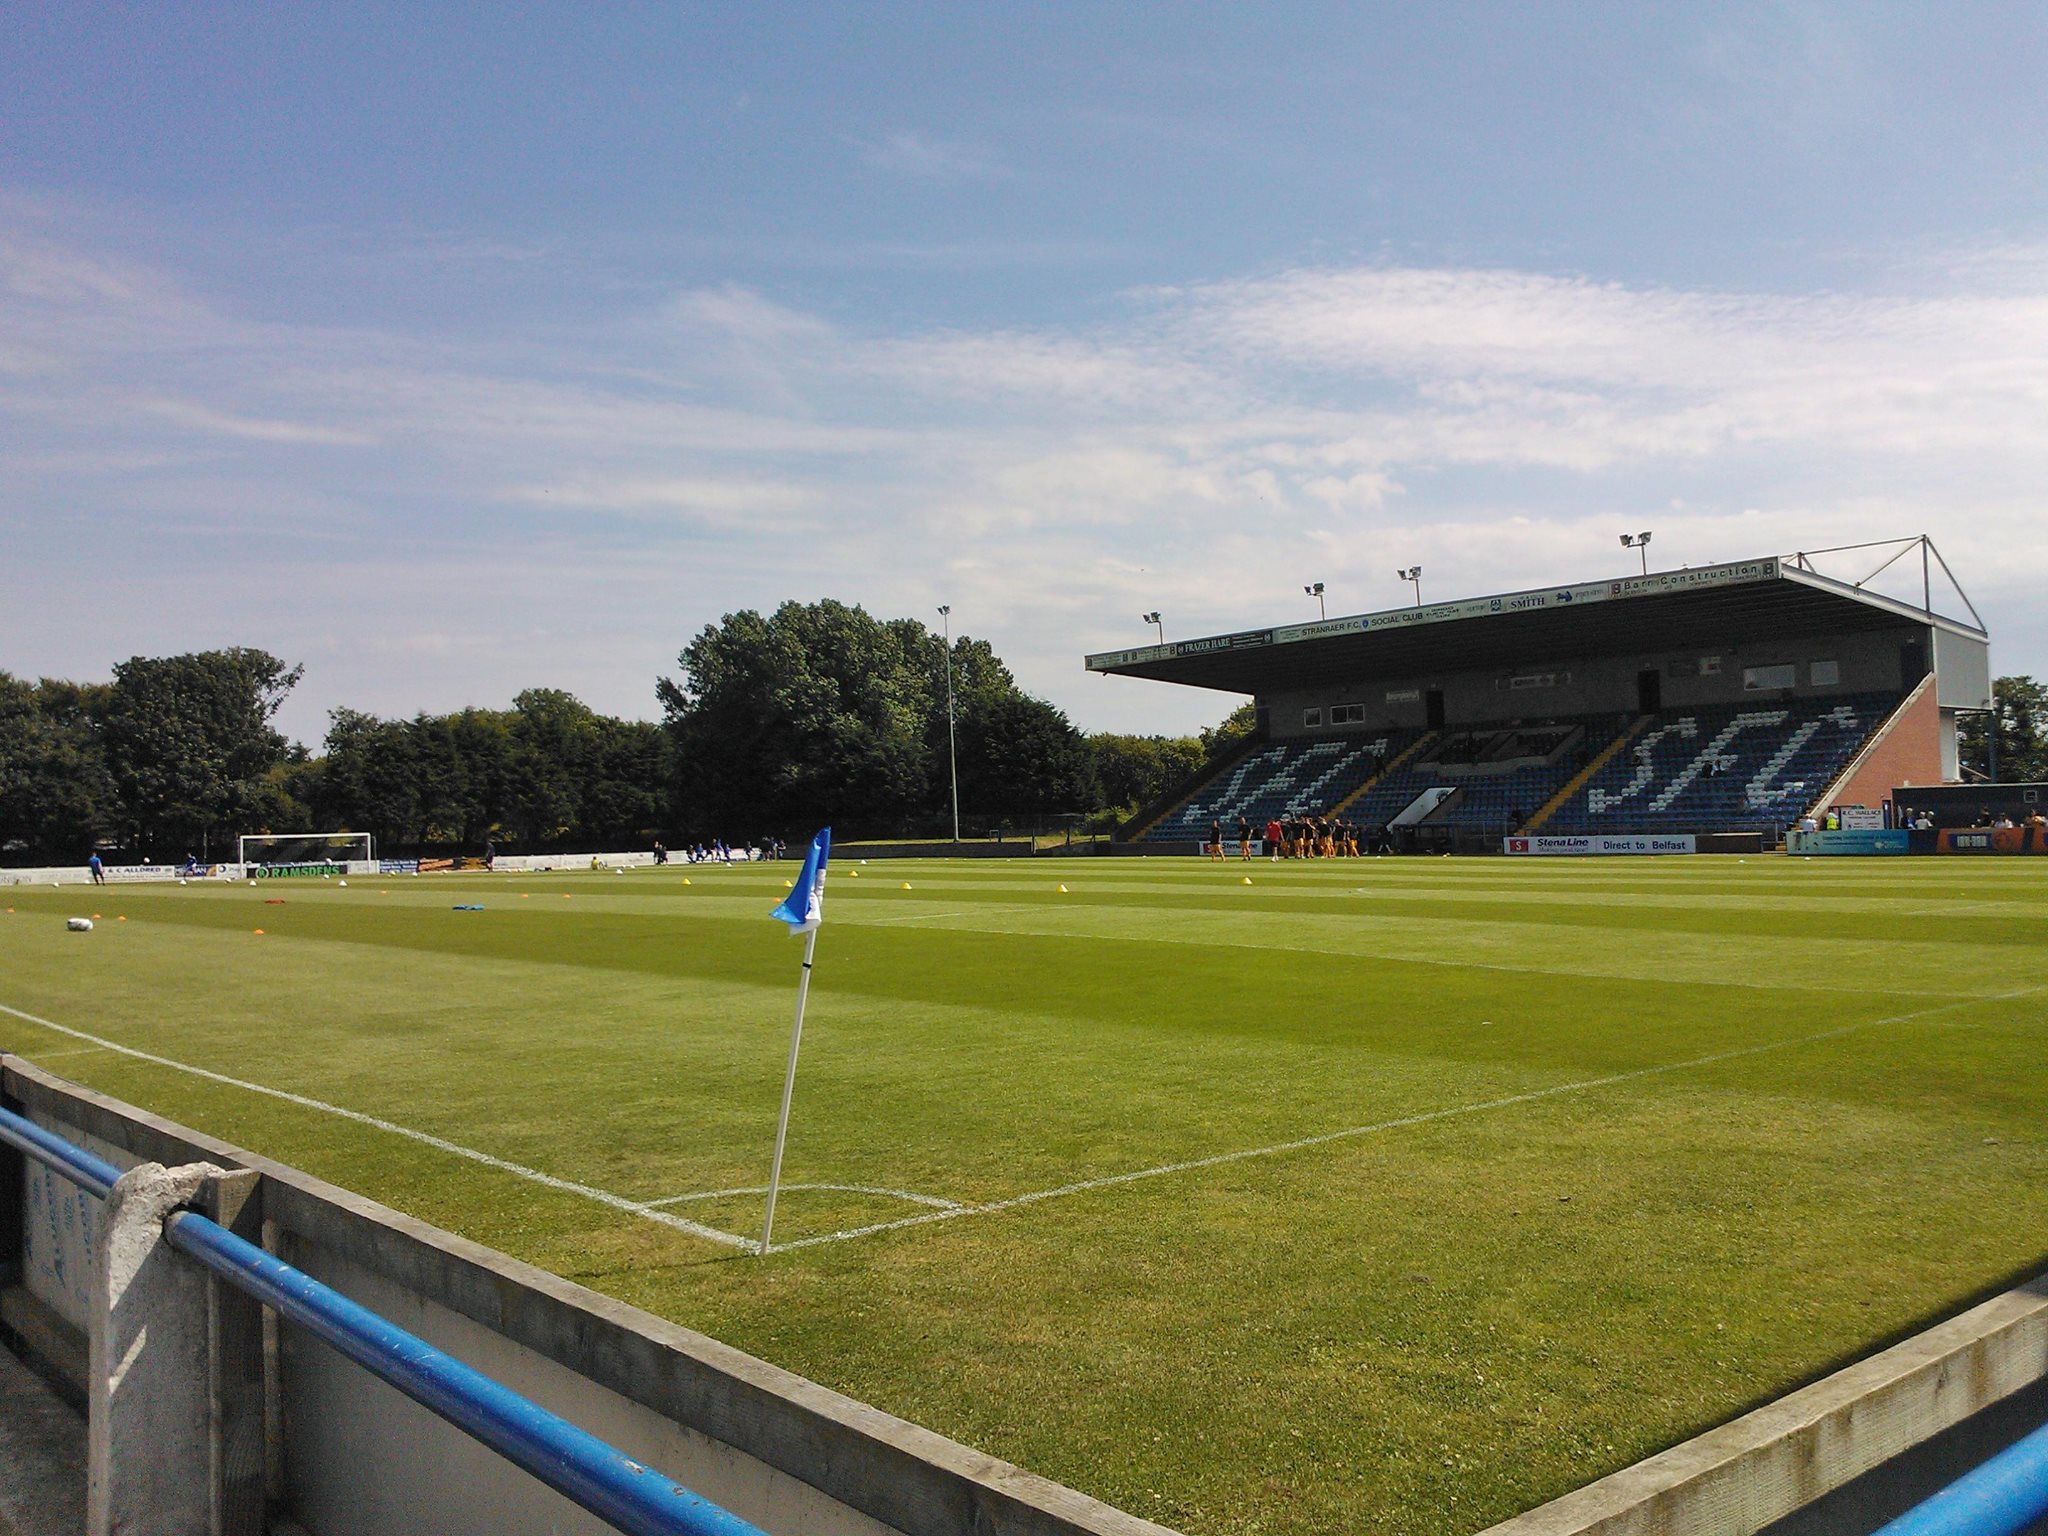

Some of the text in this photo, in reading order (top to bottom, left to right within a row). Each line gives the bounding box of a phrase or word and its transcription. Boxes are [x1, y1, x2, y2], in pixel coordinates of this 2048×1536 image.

[1624, 580, 1652, 590] Barr
[1660, 566, 1757, 585] Construction
[1510, 597, 1545, 609] SMITH
[1301, 623, 1345, 636] STRANRAER
[1371, 615, 1400, 626] SOCIAL
[1402, 612, 1423, 622] CLUB
[1184, 641, 1211, 653] FRAZER
[1211, 637, 1231, 649] HARE
[1537, 838, 1589, 846] Stena Line
[1603, 840, 1686, 849] Direct to Belfast
[271, 865, 340, 878] RAMSDENS
